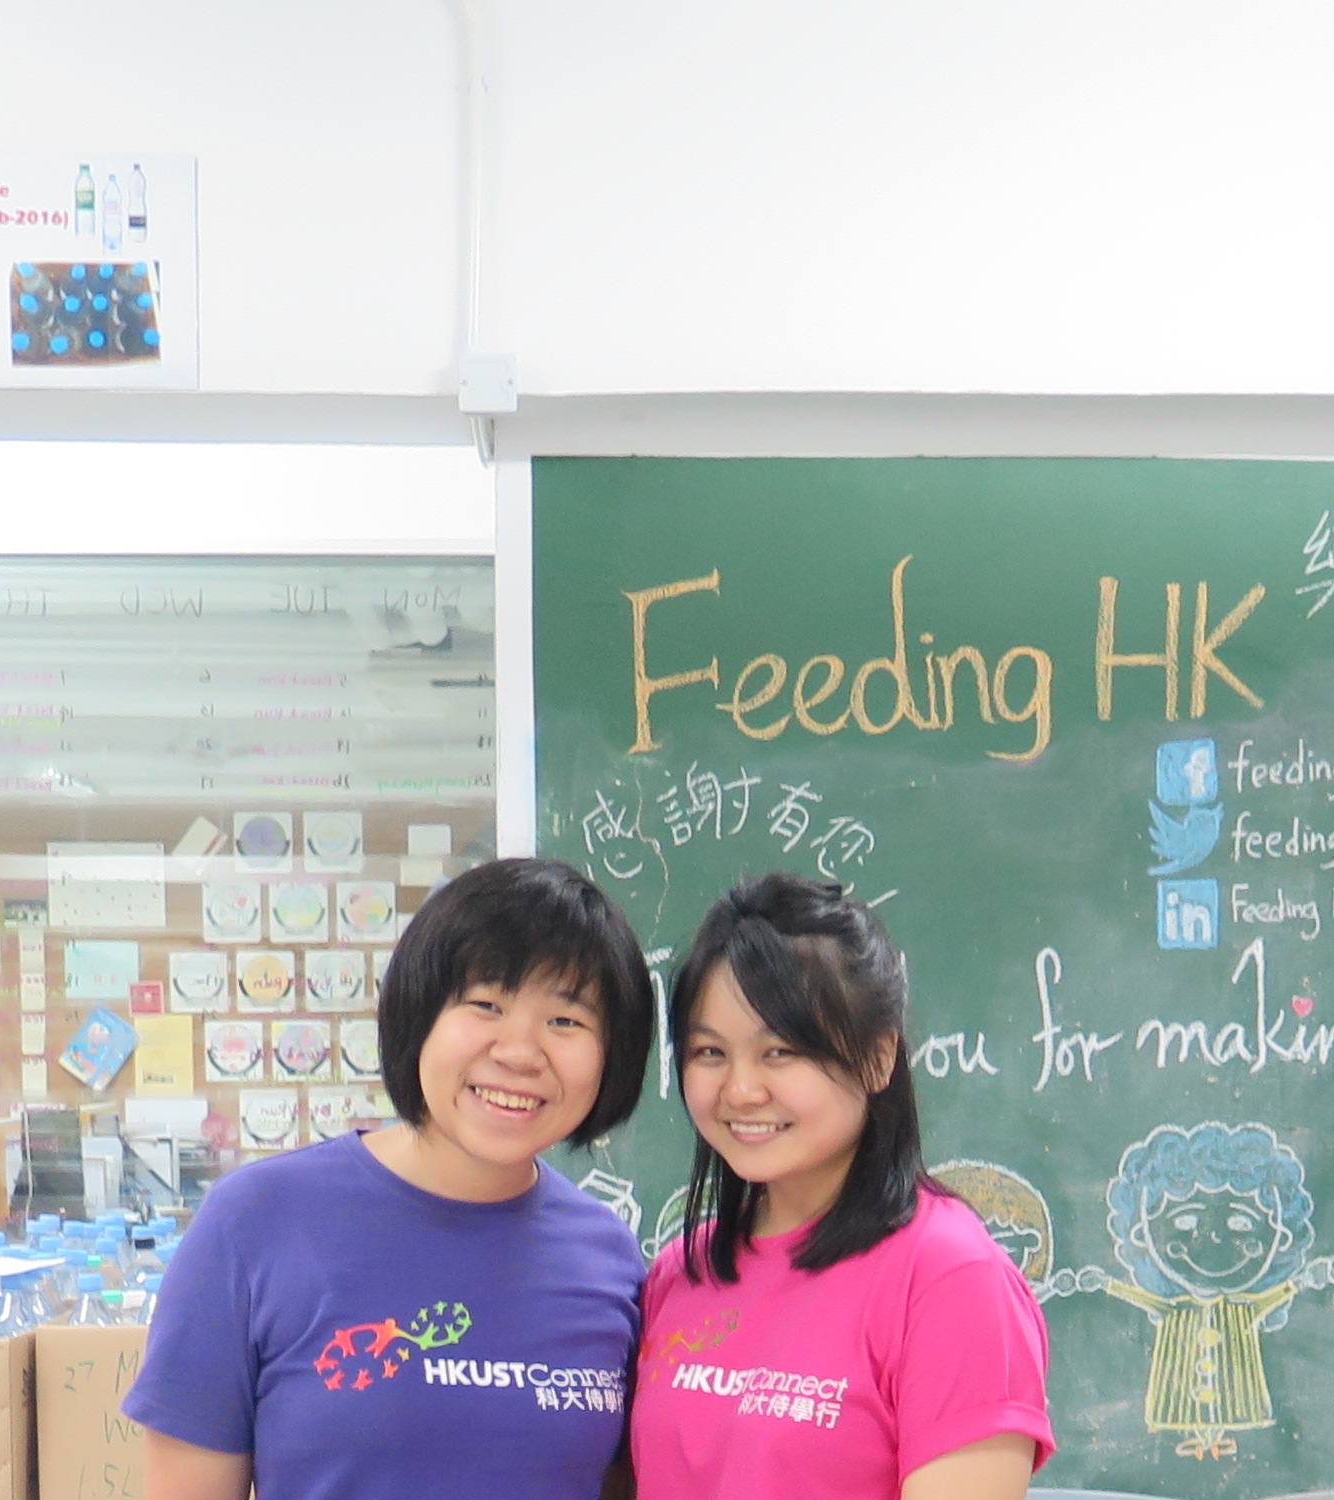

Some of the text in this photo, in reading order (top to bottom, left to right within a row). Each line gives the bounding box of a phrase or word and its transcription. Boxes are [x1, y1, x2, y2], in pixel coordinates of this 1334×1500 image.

[621, 554, 1266, 762] Feeding HK
[1231, 883, 1320, 940] Feeding
[909, 1031, 998, 1078] ou
[1033, 946, 1121, 1092] for
